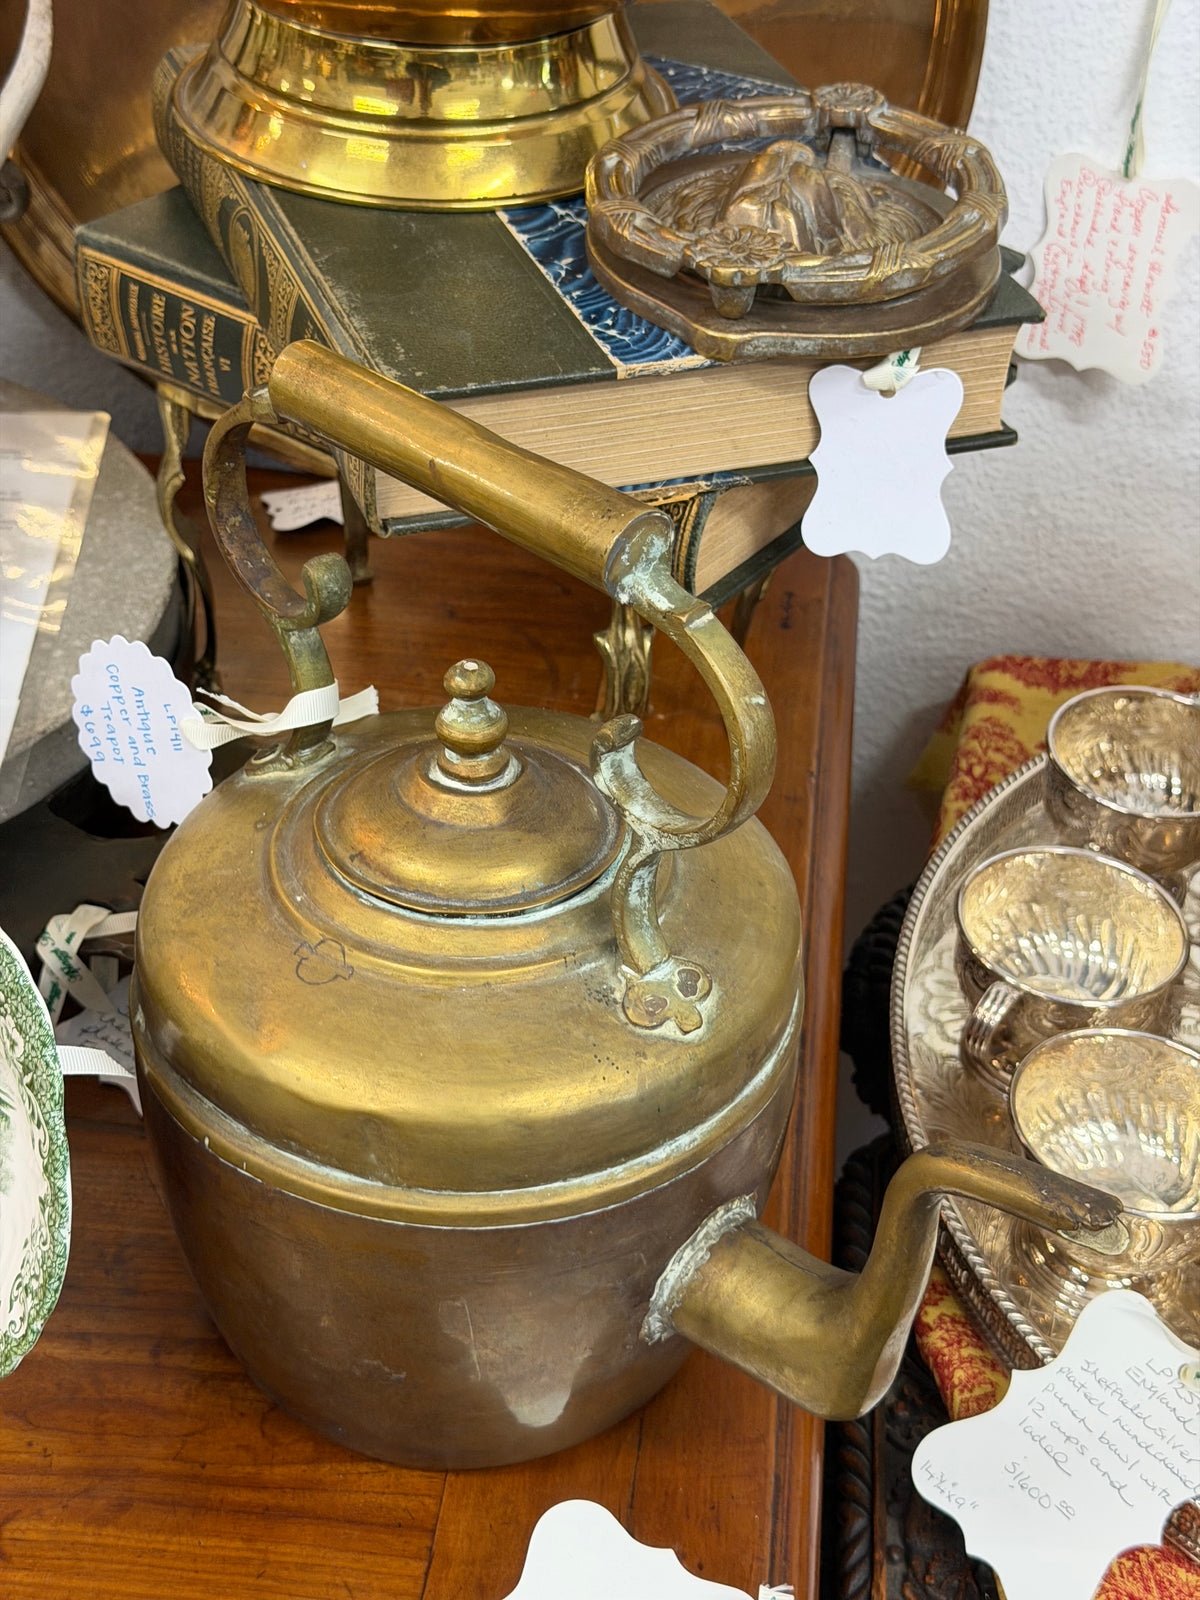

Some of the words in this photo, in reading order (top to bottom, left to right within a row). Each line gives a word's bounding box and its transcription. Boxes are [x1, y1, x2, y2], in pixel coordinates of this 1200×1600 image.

[151, 292, 174, 375] HISTOIRE
[180, 302, 204, 388] NATION
[201, 314, 221, 396] FRANÇAISE
[219, 357, 231, 372] VI
[80, 704, 106, 763] $699
[101, 700, 125, 764] Teapot
[106, 663, 132, 727] Copper
[128, 735, 146, 767] and
[138, 774, 156, 818] Brass
[131, 686, 156, 756] Antique
[164, 703, 183, 752] LP1411
[1056, 1366, 1108, 1416] plated
[1125, 1365, 1197, 1436] England
[1027, 1397, 1043, 1419] 12
[1050, 1418, 1088, 1456] cups
[1089, 1455, 1135, 1508] and
[1042, 1382, 1093, 1433] punch
[1098, 1430, 1139, 1472] bowl
[1139, 1471, 1174, 1507] with
